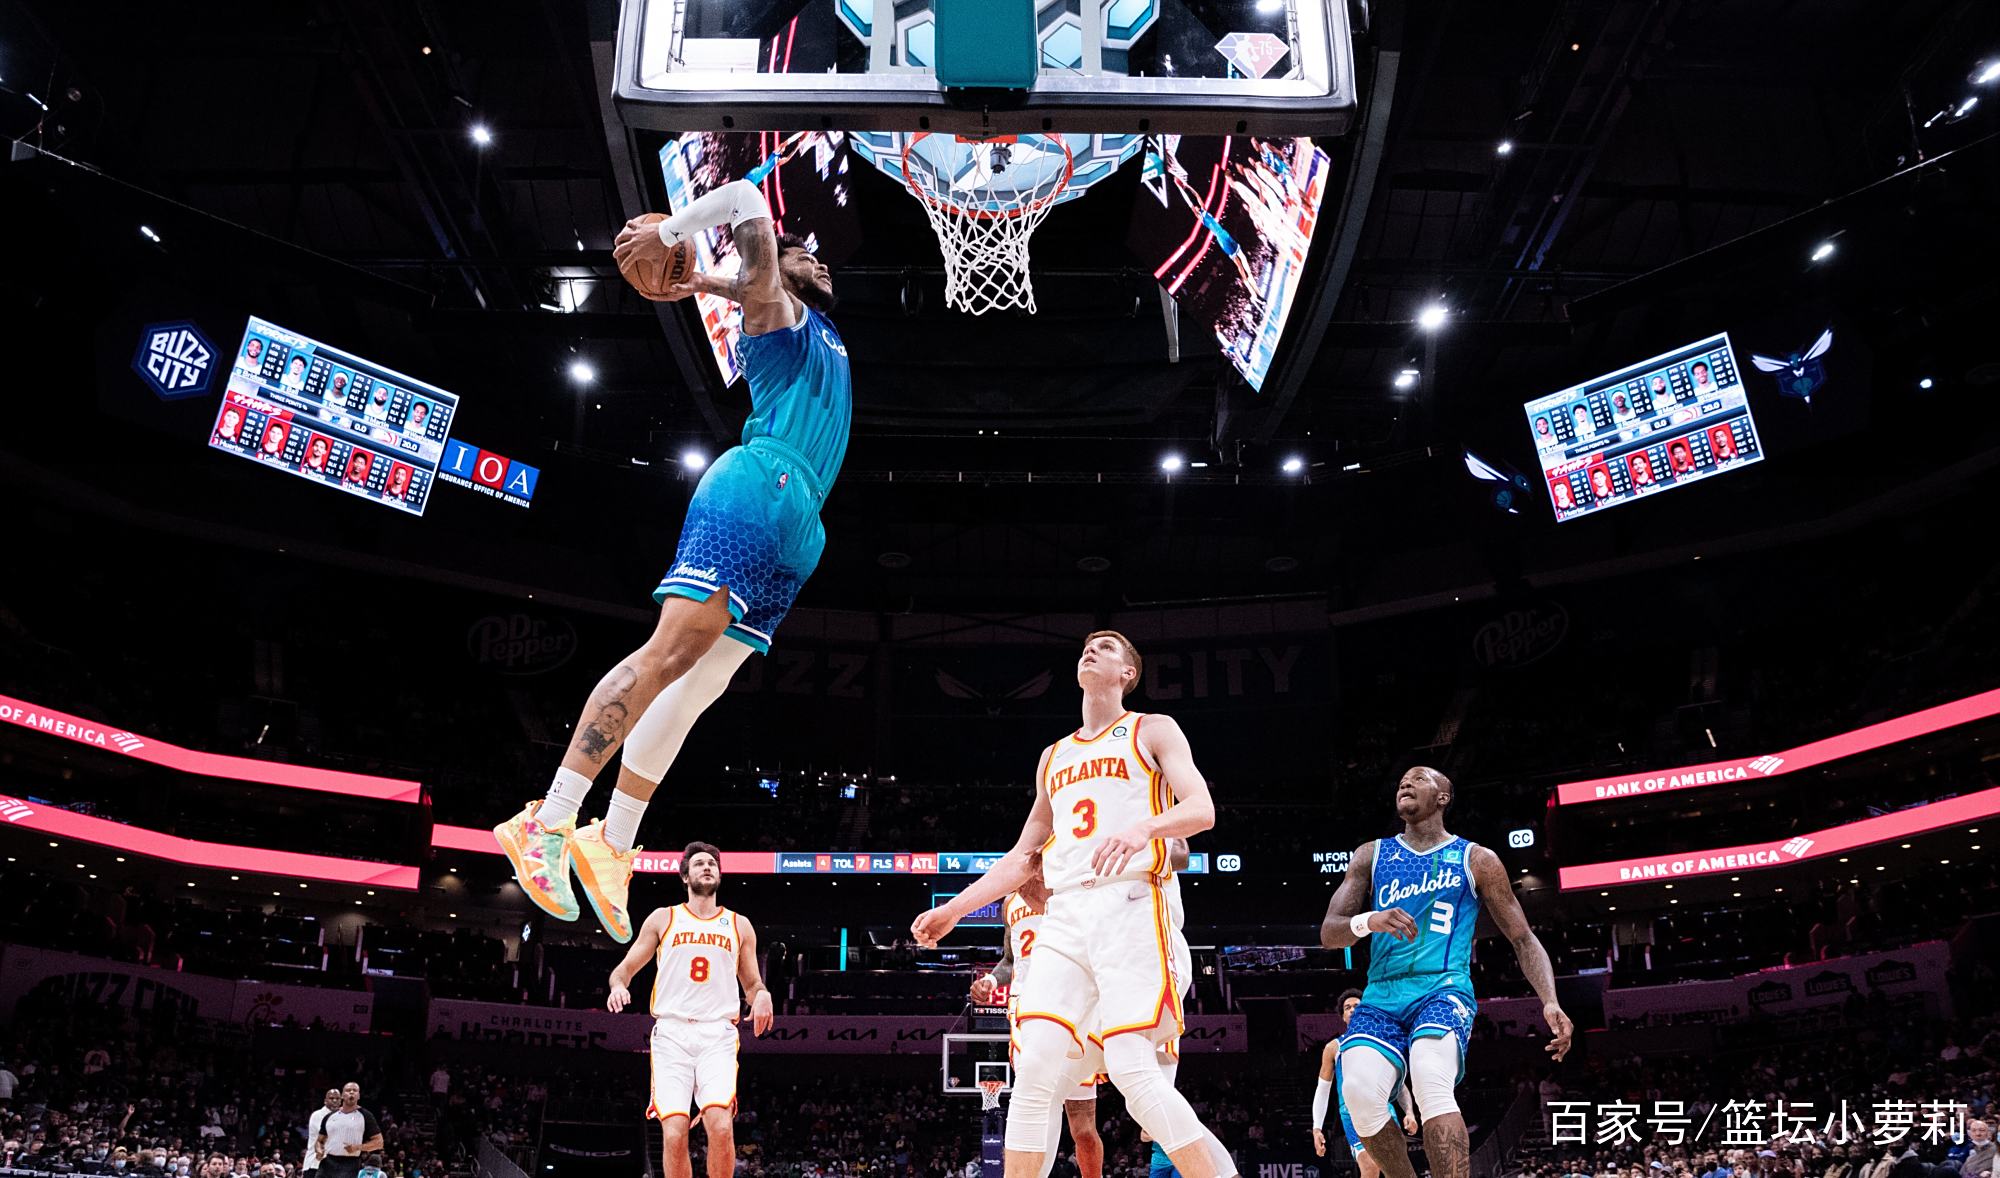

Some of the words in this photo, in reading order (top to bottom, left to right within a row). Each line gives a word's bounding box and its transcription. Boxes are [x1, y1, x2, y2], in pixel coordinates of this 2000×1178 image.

[150, 330, 210, 369] BUZZ
[147, 352, 200, 389] CITY
[1653, 418, 1667, 428] 0.0
[1702, 401, 1720, 412] 20.0
[353, 422, 367, 433] 0.0
[401, 439, 417, 450] 20.0
[452, 446, 529, 495] IOA
[438, 472, 472, 489] INSURANCE
[473, 483, 495, 497] OFFICE
[495, 491, 504, 499] OF
[504, 494, 530, 509] AMERICA
[509, 614, 547, 640] Dr
[478, 618, 571, 668] Pepper
[727, 649, 867, 701] UZZ
[1145, 647, 1302, 701] CITY
[0, 705, 23, 721] OF
[25, 713, 106, 746] AMERICA
[1050, 757, 1130, 799] ATLANTA
[1595, 780, 1641, 799] BANK
[1644, 777, 1666, 791] OF
[1669, 766, 1748, 788] AMERICA
[1072, 798, 1098, 840] 3
[1511, 833, 1531, 845] CC
[633, 857, 681, 871] ERICA
[782, 858, 812, 868] Assists
[833, 858, 854, 869] TOL
[857, 858, 865, 869] 7
[873, 858, 892, 869] FLS
[895, 858, 904, 869] 4
[911, 857, 937, 870] ATL
[946, 857, 961, 870] 14
[1220, 858, 1238, 869] CC
[1313, 852, 1324, 863] IN
[1325, 852, 1348, 863] FOR
[1620, 862, 1668, 880] BANK
[1671, 859, 1694, 874] OF
[1698, 849, 1780, 872] AMERICA
[1378, 867, 1462, 909] Charlotte
[1429, 900, 1454, 935] 3
[671, 931, 733, 953] ATLANTA
[689, 955, 711, 983] 8
[491, 1016, 582, 1032] CHARLOTTE
[1257, 1163, 1303, 1178] HIVE
